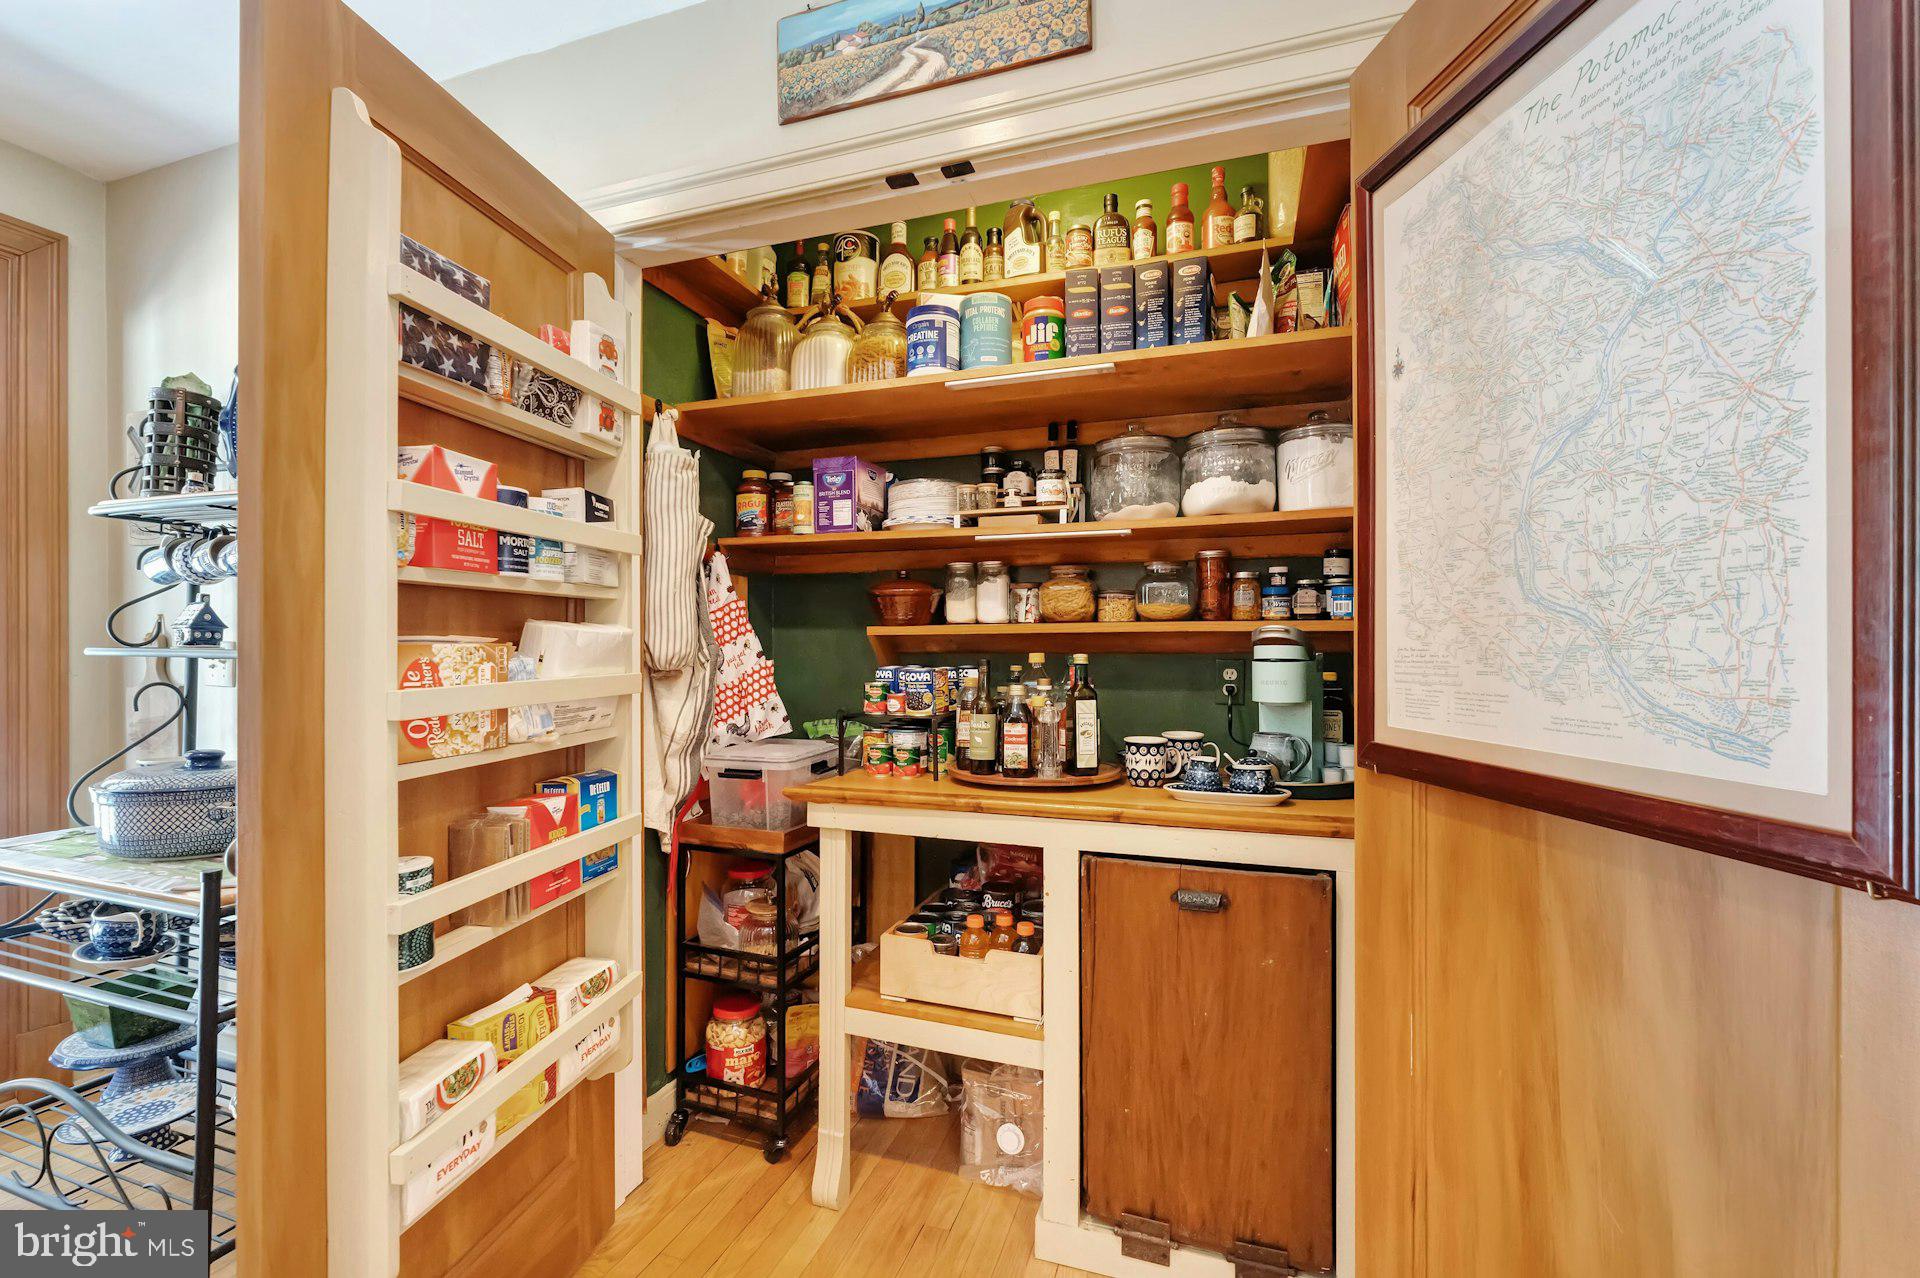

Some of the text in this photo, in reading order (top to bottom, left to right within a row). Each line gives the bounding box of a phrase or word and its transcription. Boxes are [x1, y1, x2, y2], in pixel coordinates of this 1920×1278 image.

[1671, 54, 1689, 70] The
[1693, 25, 1732, 55] German
[1523, 1, 1682, 131] The Potomac
[1556, 109, 1574, 124] from
[1579, 68, 1627, 108] Brunswick
[1631, 57, 1641, 68] to
[1614, 81, 1623, 96] of
[1098, 228, 1127, 238] RUFUS
[1098, 236, 1127, 245] TEAGUE
[908, 330, 939, 343] CREATINE
[1026, 322, 1058, 345] Jif
[818, 489, 835, 497] BRITISH
[457, 529, 484, 549] SALT
[513, 548, 528, 557] SALT
[876, 670, 893, 679] OYA
[906, 672, 931, 682] GOYA
[1323, 722, 1342, 733] ONEY
[982, 894, 1013, 908] Bruce's
[582, 1032, 612, 1062] EVERYDAY
[436, 1141, 481, 1182] EVERYDAY
